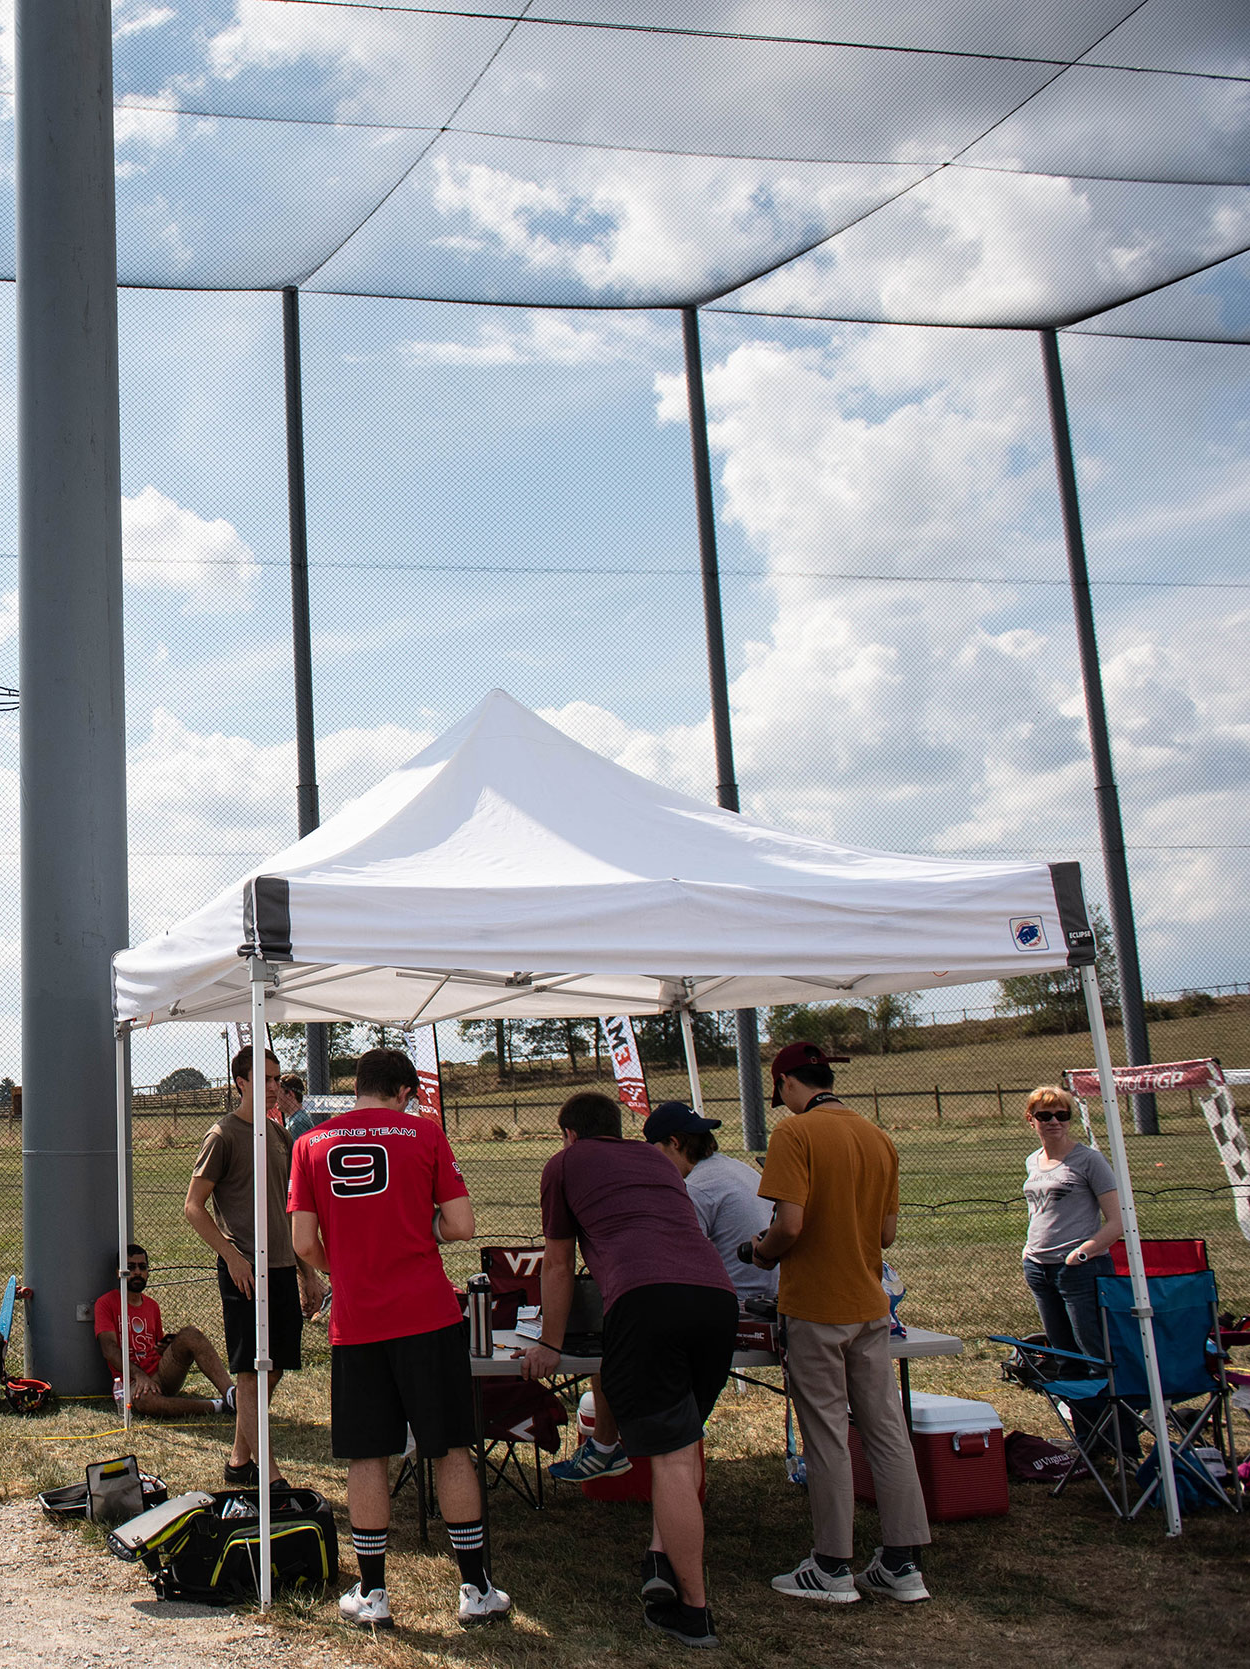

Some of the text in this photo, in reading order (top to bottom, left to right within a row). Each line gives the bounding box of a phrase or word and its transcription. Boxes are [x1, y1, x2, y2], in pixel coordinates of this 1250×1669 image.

[1069, 930, 1092, 939] ECLIPSE
[309, 1127, 417, 1147] RACING TEAM
[327, 1143, 389, 1198] 9
[503, 1252, 545, 1276] VT
[1041, 1453, 1071, 1466] Virginia
